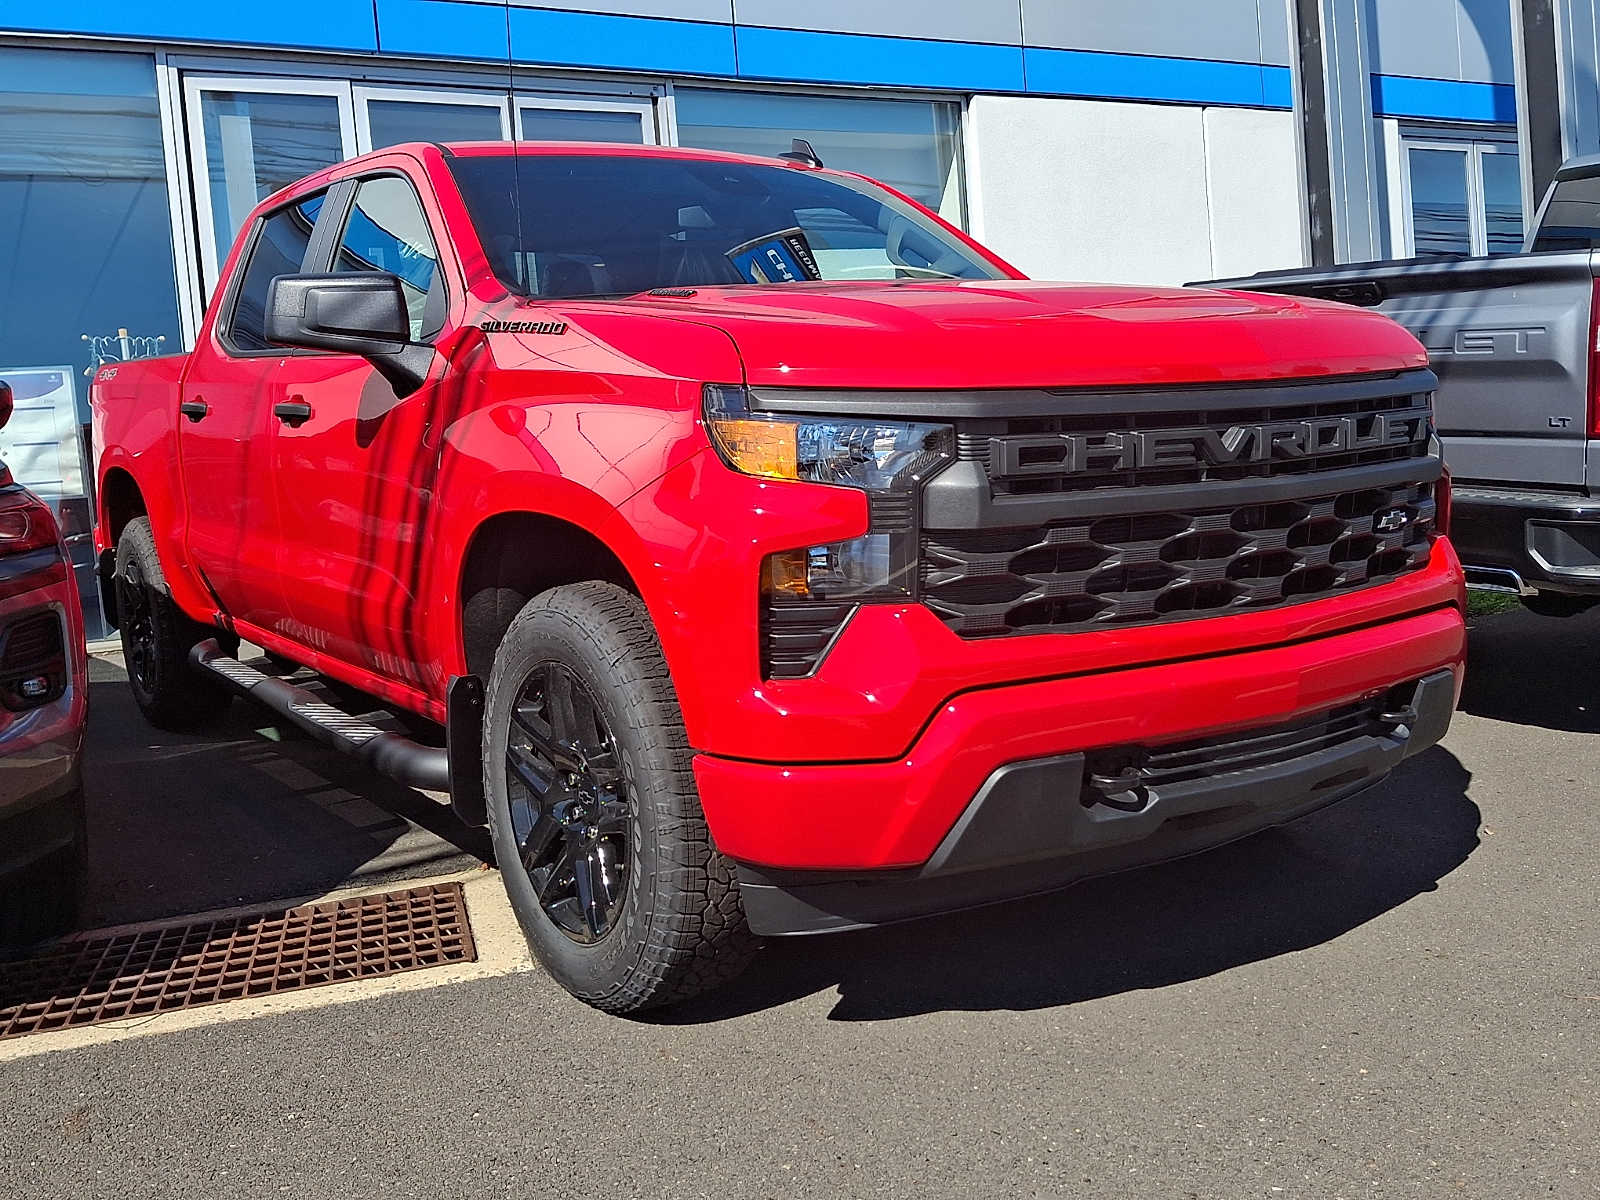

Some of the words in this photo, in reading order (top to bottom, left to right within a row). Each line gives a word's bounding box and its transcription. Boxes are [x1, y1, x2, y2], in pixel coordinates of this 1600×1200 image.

[480, 320, 568, 335] SILVERADO
[1548, 417, 1571, 427] LT
[990, 410, 1430, 476] CHEVROLET
